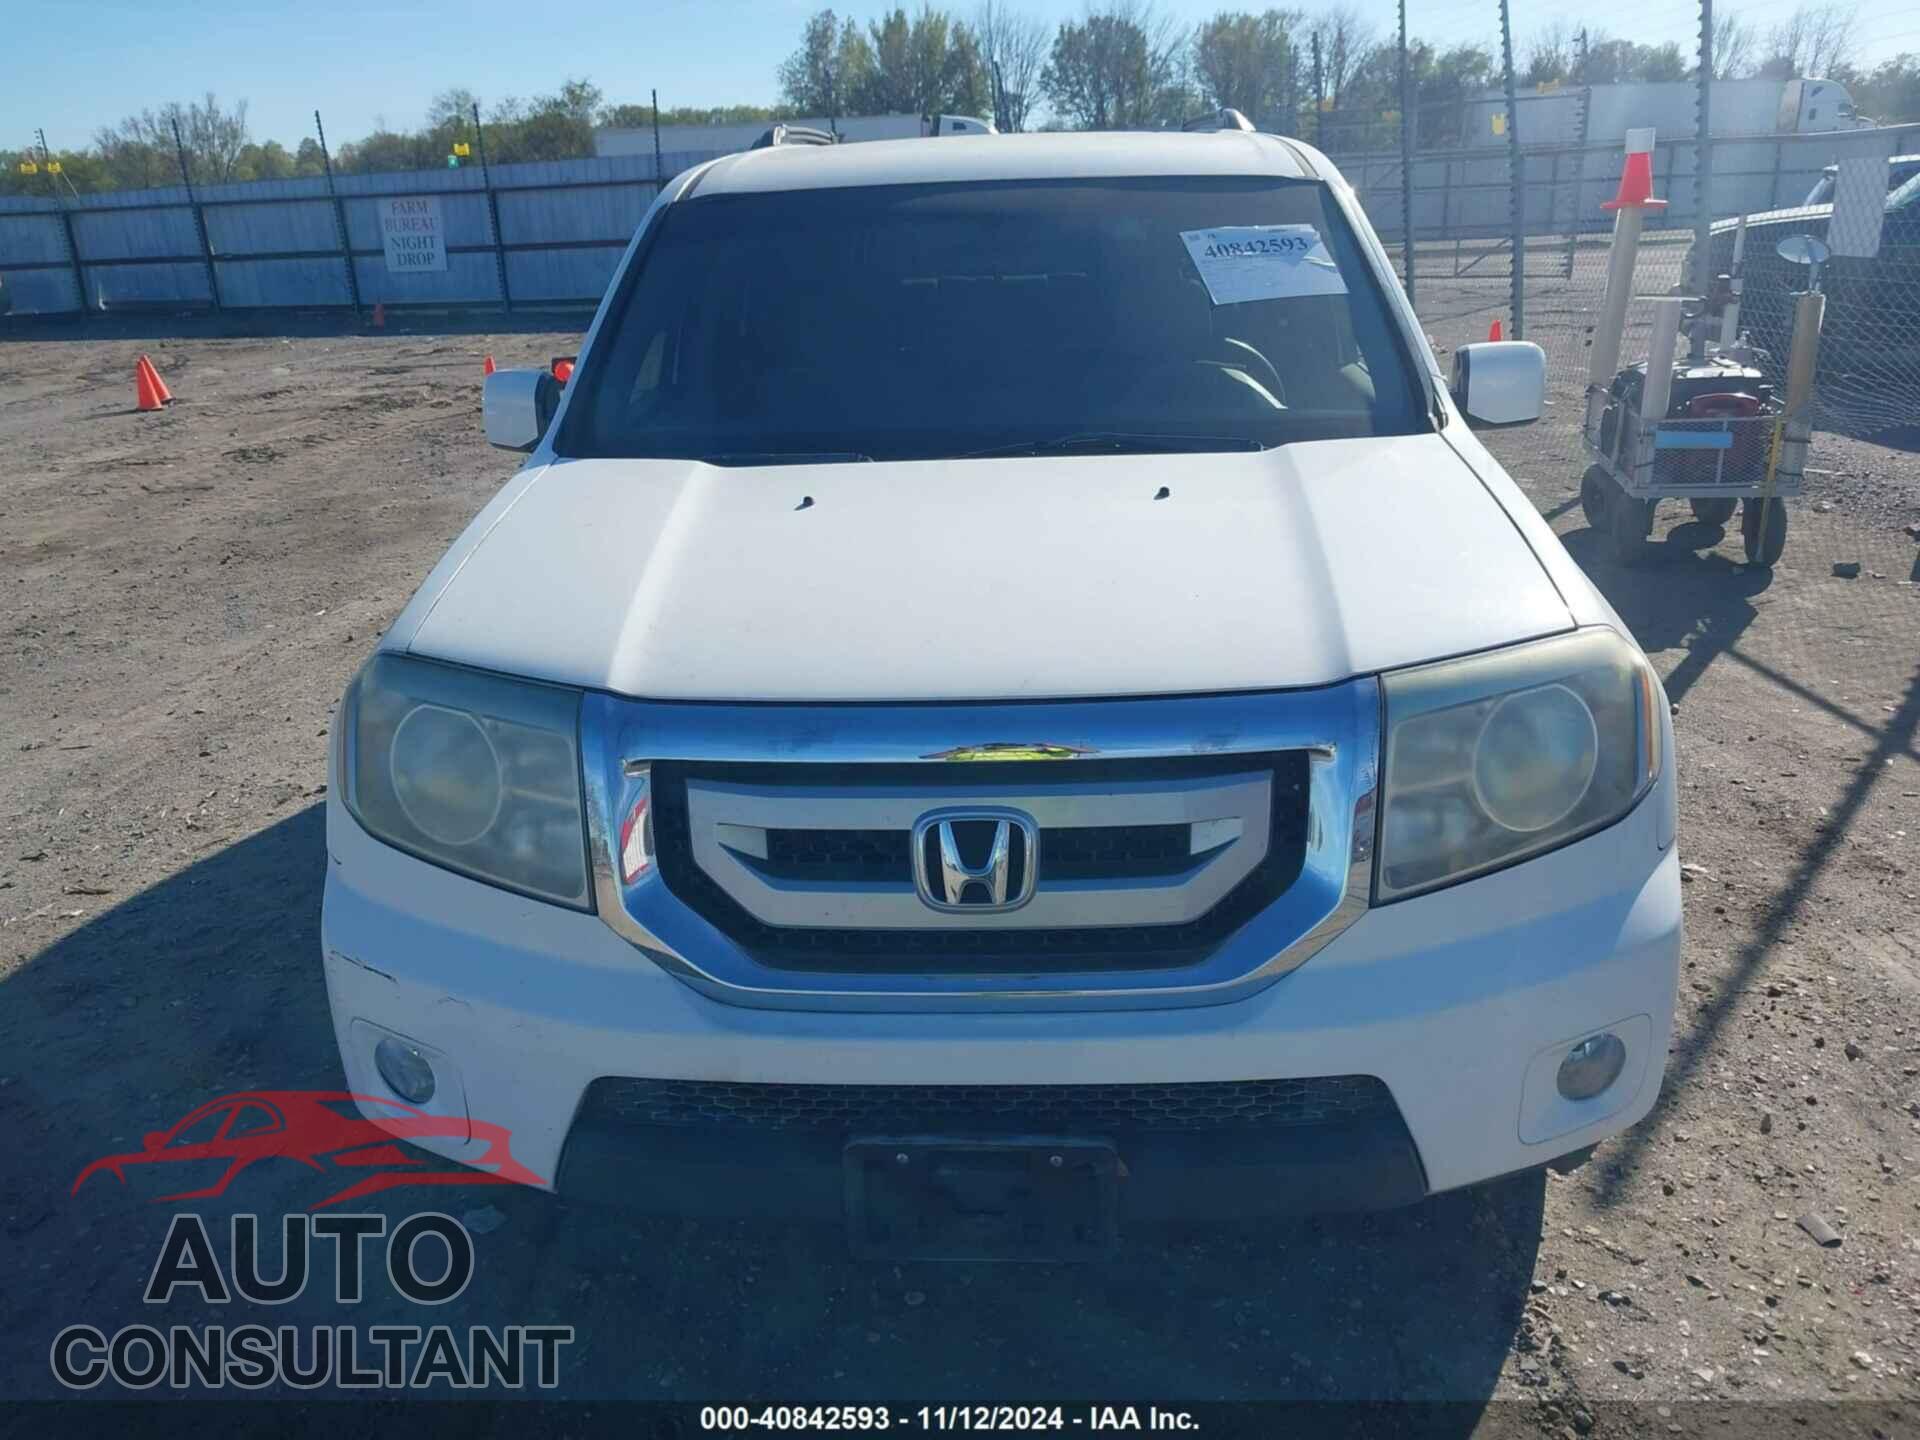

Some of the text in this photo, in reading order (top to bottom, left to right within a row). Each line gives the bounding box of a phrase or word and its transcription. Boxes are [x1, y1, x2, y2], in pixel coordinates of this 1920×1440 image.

[391, 200, 432, 216] FARM
[385, 216, 439, 232] BUREAU
[391, 235, 435, 250] NIGHT
[1205, 237, 1308, 258] 40842593
[397, 251, 435, 266] DROP
